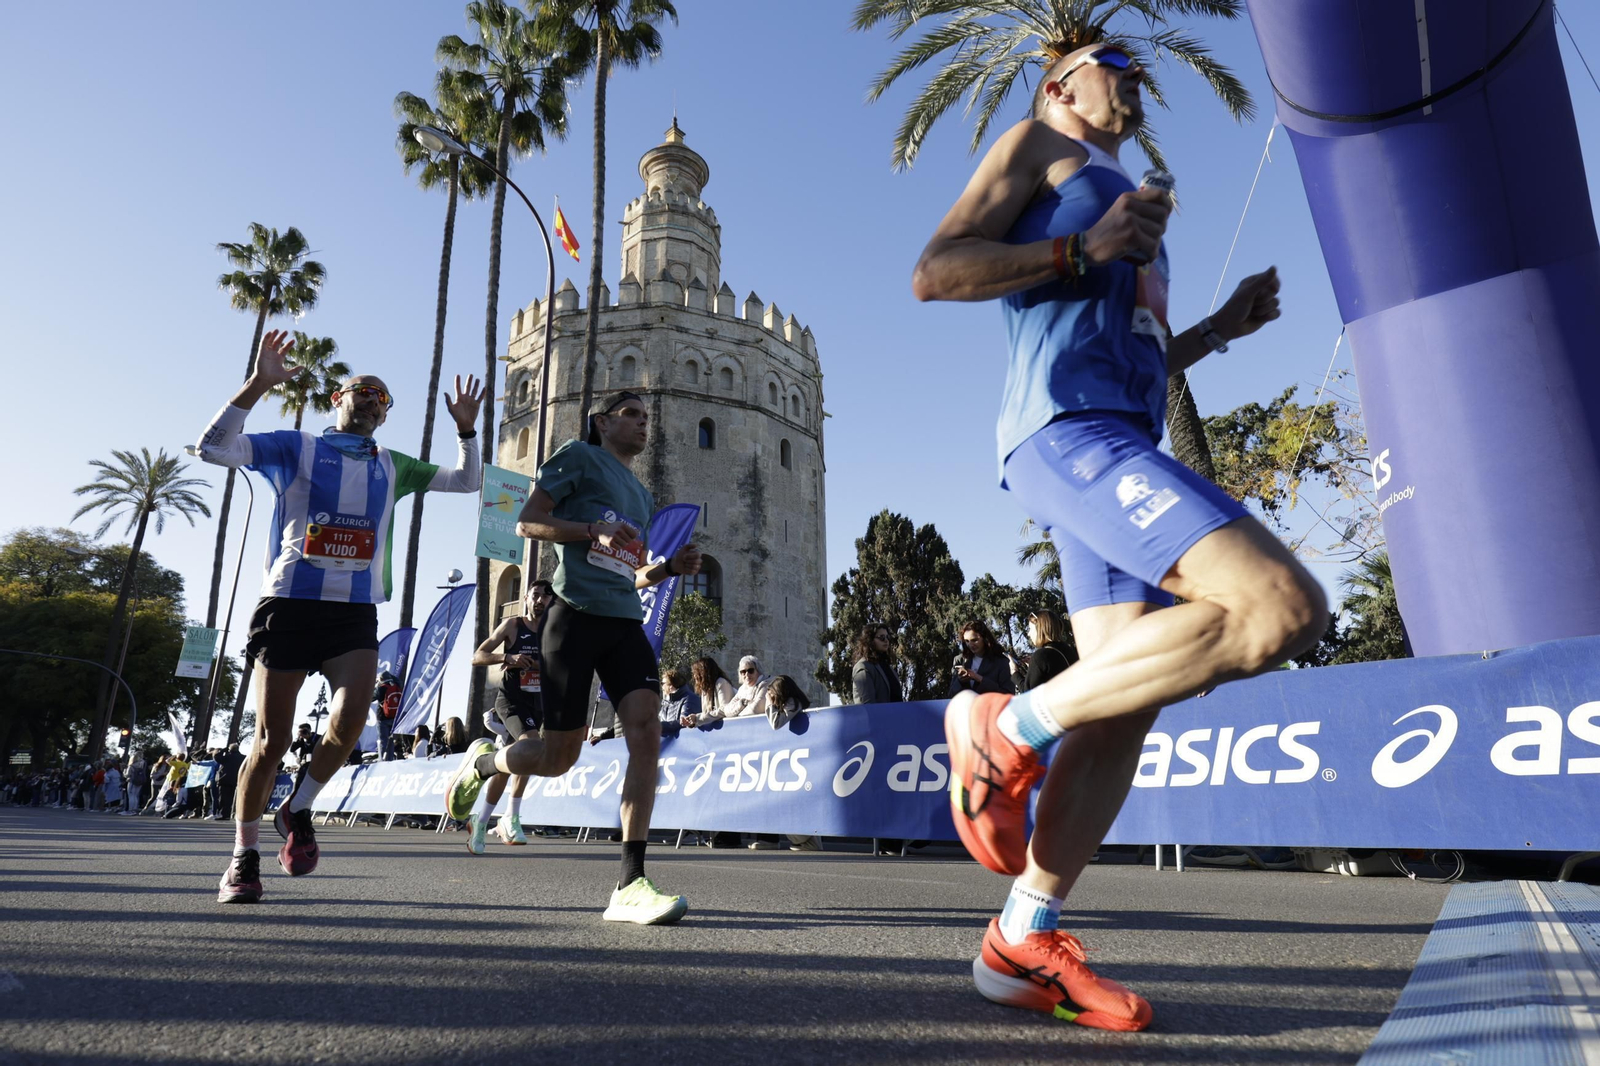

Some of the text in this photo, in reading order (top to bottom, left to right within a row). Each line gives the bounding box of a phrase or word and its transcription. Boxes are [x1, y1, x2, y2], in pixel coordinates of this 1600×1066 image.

[486, 476, 528, 495] HAZ MATCH
[1394, 485, 1415, 503] body
[334, 516, 370, 527] ZURICH
[482, 513, 498, 523] CON
[481, 520, 493, 530] DE
[496, 523, 505, 532] TU
[333, 533, 353, 542] 1117
[323, 543, 357, 557] YUDO
[591, 540, 613, 555] DAS
[654, 609, 665, 637] sound
[660, 589, 672, 612] mind,
[720, 748, 810, 792] asics
